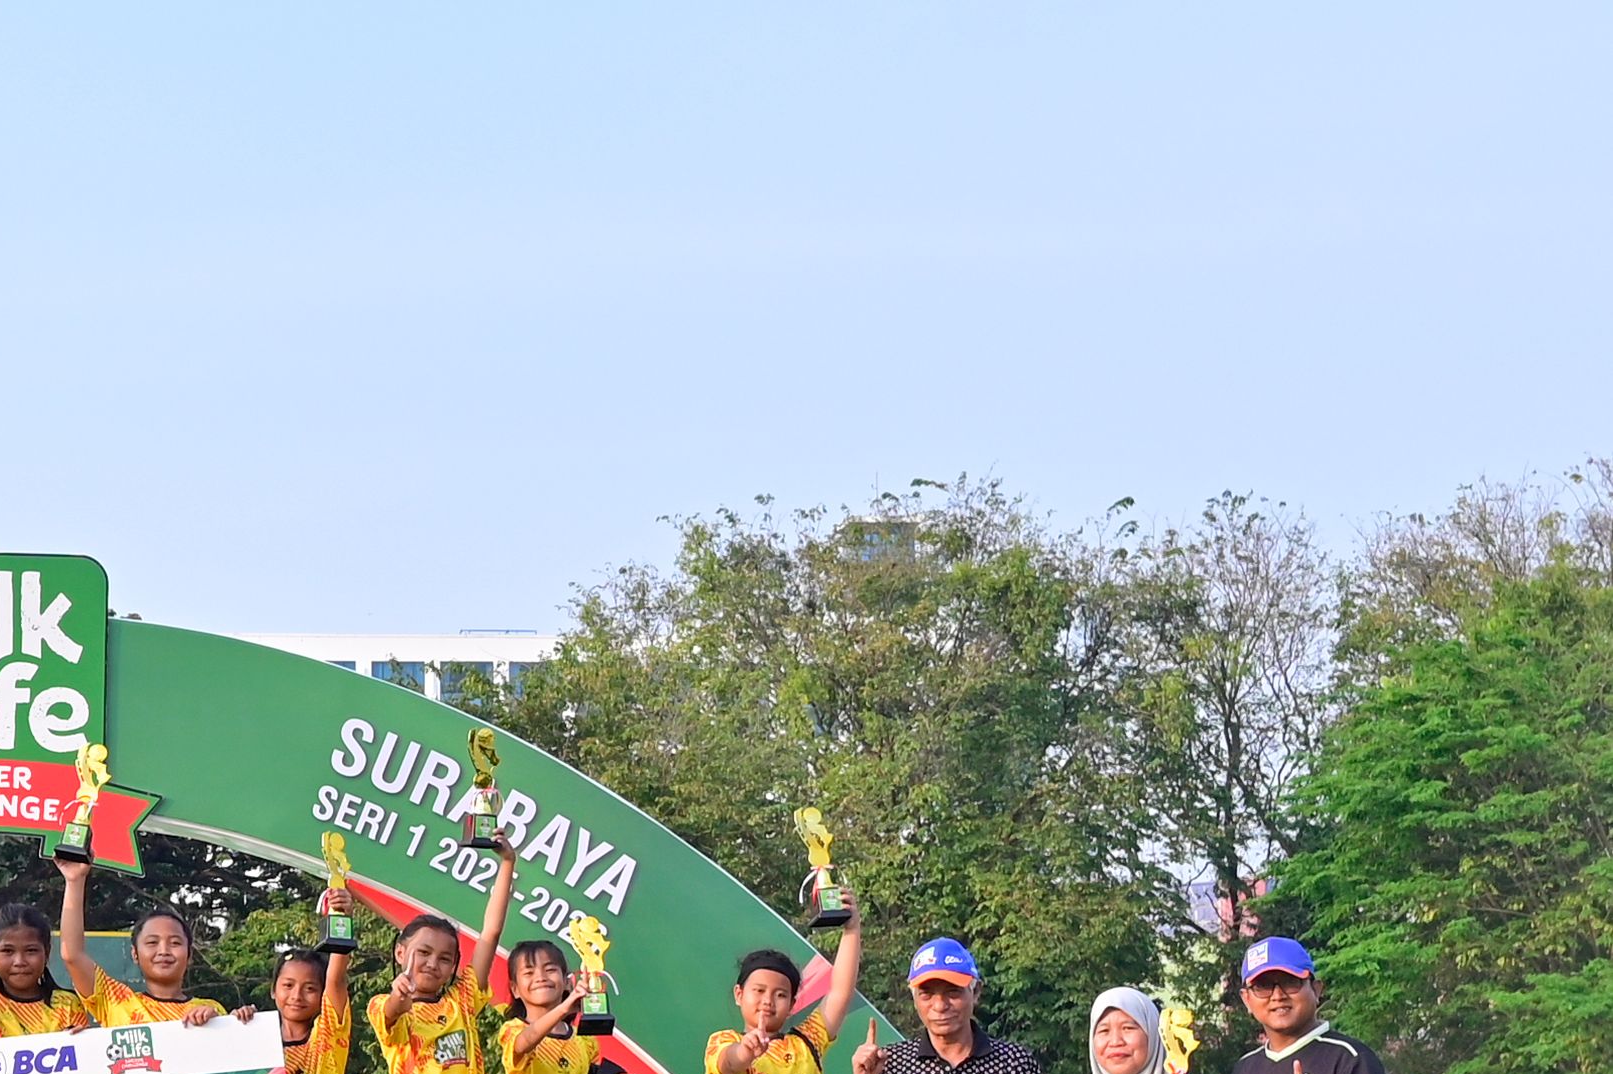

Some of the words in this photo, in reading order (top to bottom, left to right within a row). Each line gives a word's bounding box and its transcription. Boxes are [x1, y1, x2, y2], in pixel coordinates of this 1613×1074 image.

[312, 785, 399, 846] SERI
[406, 824, 426, 857] 1
[116, 1028, 149, 1045] Milk
[438, 1032, 465, 1050] Milk
[122, 1042, 152, 1058] Life
